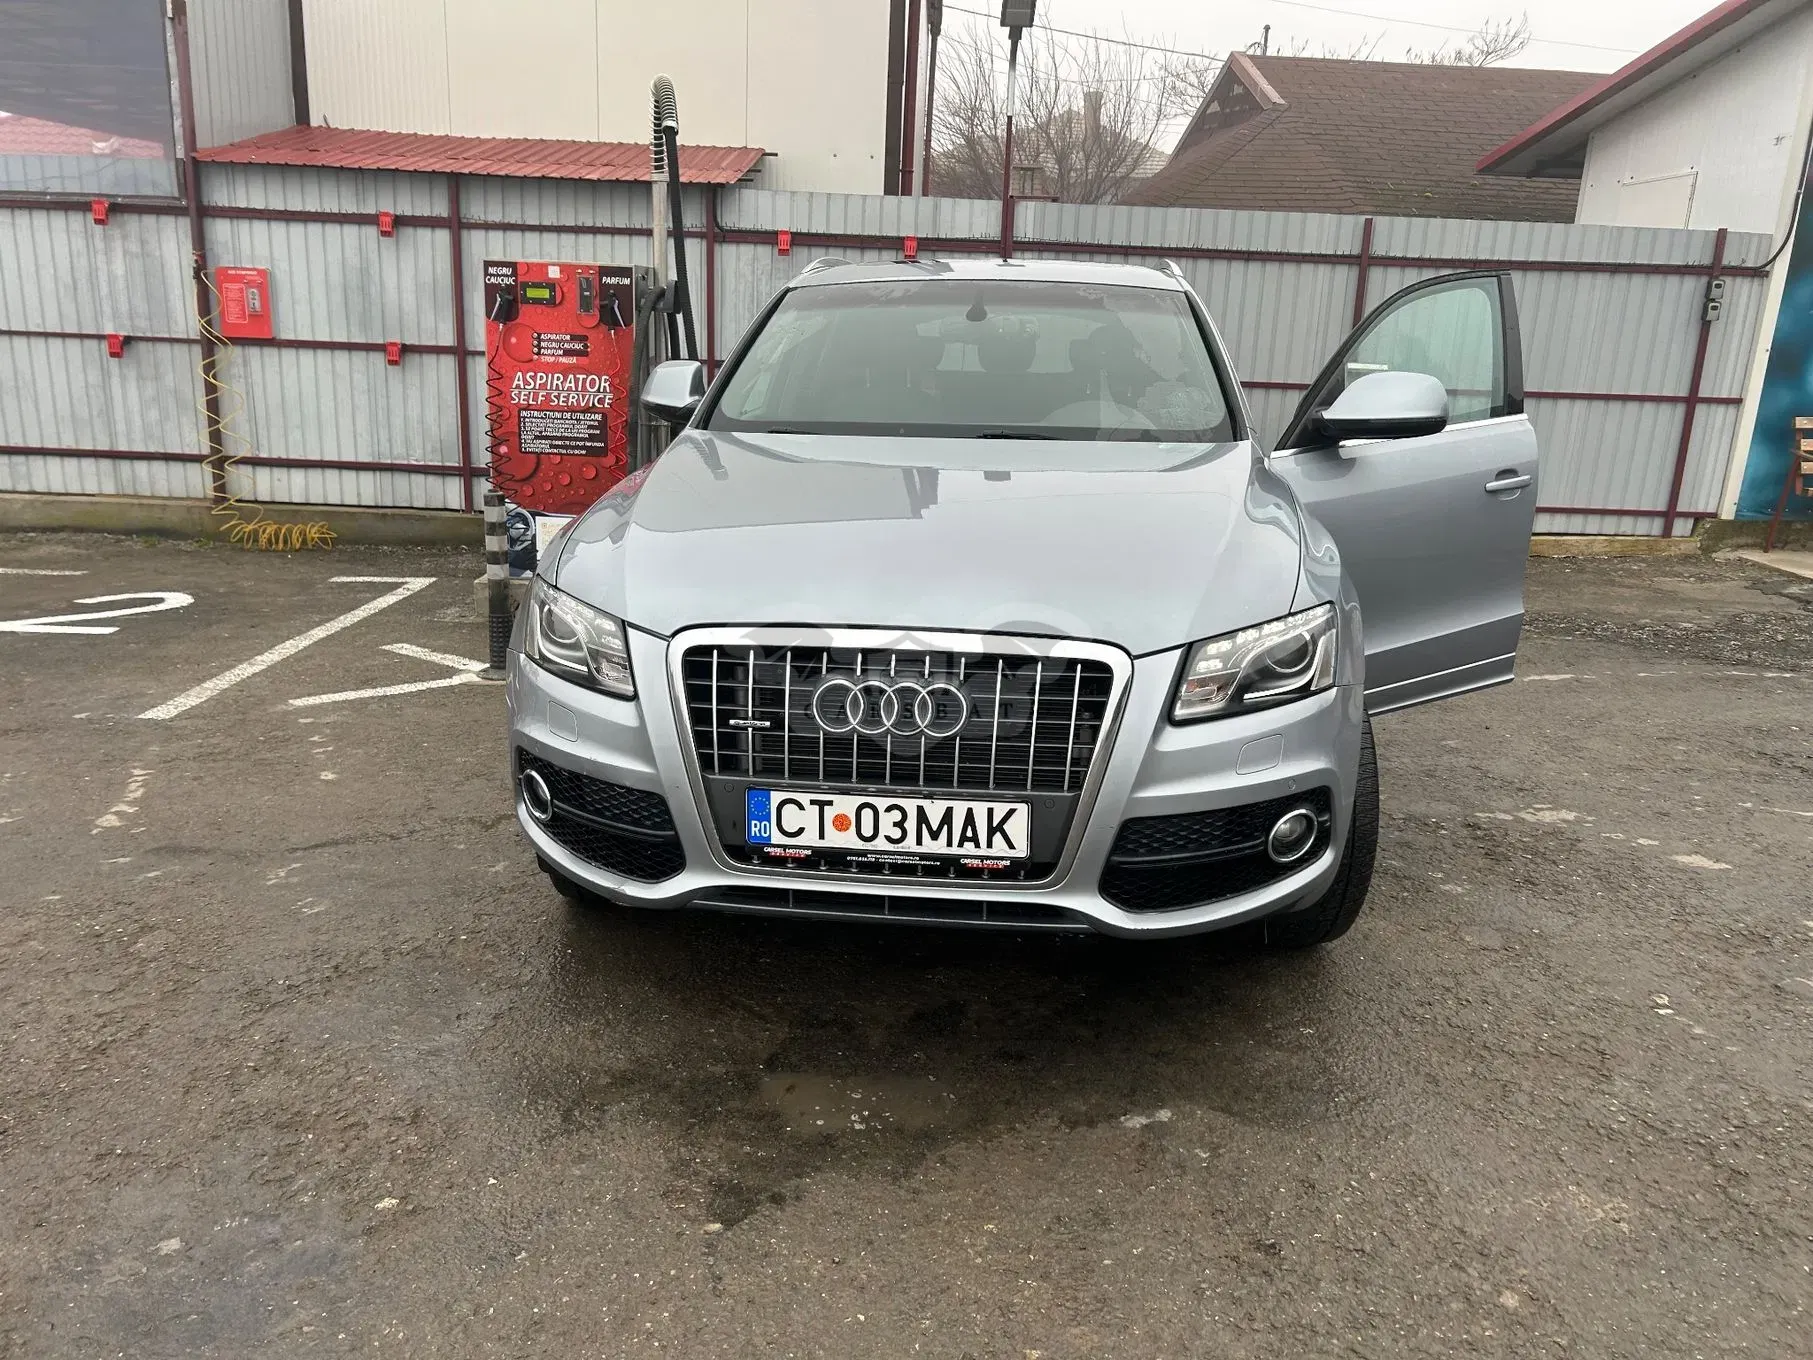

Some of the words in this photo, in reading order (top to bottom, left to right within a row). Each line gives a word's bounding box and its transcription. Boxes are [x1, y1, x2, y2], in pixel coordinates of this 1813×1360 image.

[602, 277, 630, 285] PARFUM
[512, 372, 611, 393] ASPIRATOR
[510, 391, 546, 406] SELF
[550, 393, 614, 408] SERVICE
[775, 798, 834, 840] CT
[751, 820, 770, 838] RO
